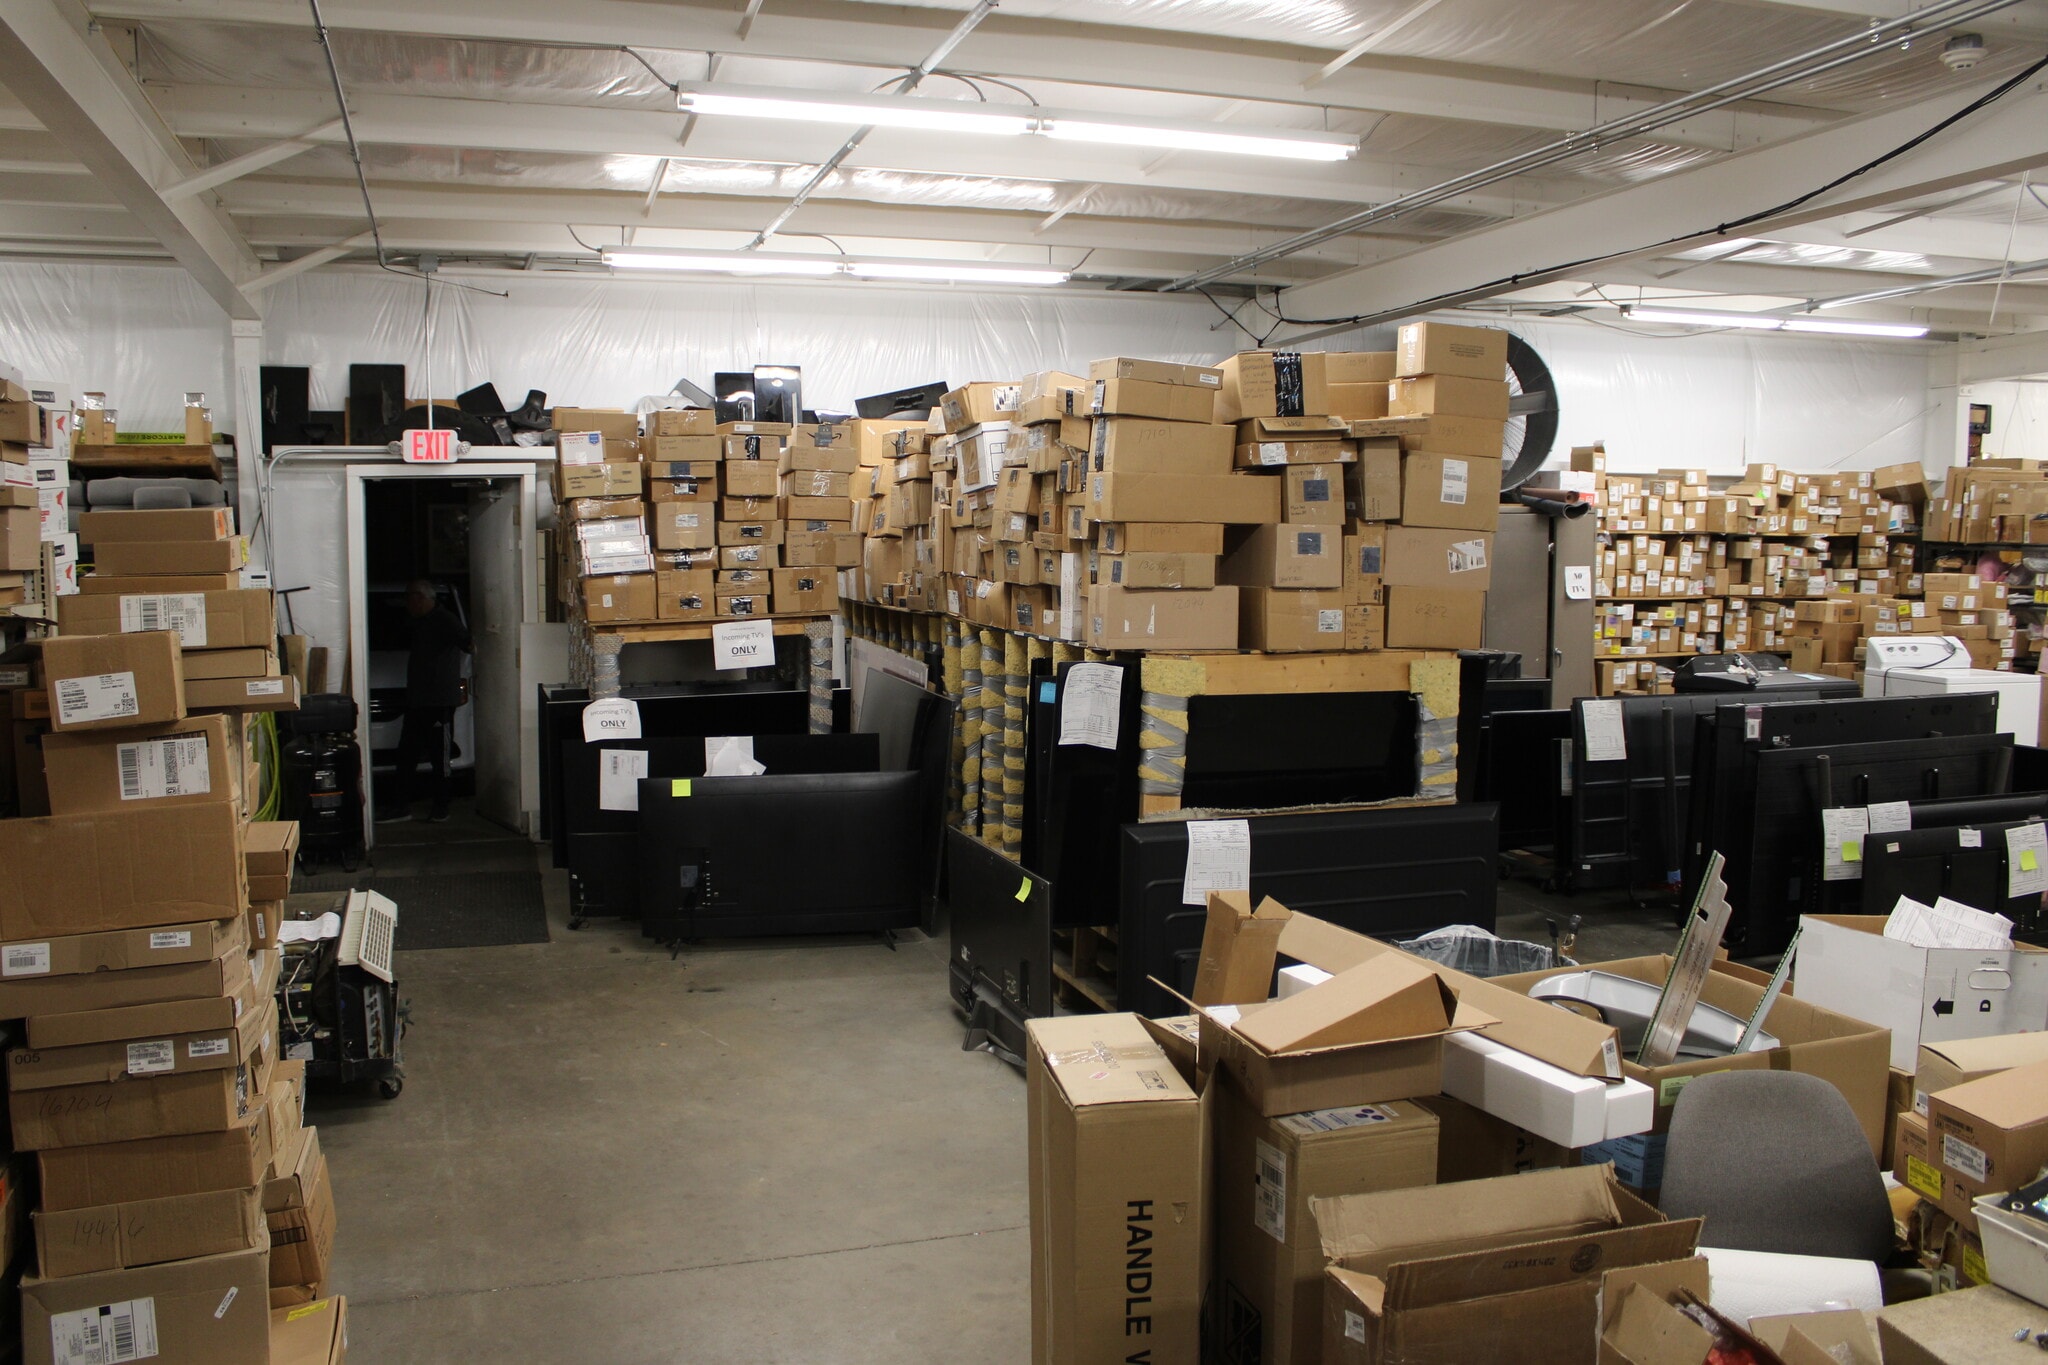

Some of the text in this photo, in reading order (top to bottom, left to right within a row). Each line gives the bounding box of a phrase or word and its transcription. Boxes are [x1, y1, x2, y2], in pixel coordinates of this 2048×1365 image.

[412, 431, 451, 460] EXIT
[1573, 572, 1583, 580] NO
[722, 631, 765, 641] Incoming TV's
[731, 645, 757, 655] ONLY
[600, 720, 626, 728] ONLY
[15, 1052, 41, 1065] 005
[1125, 1200, 1153, 1337] HANDLE
